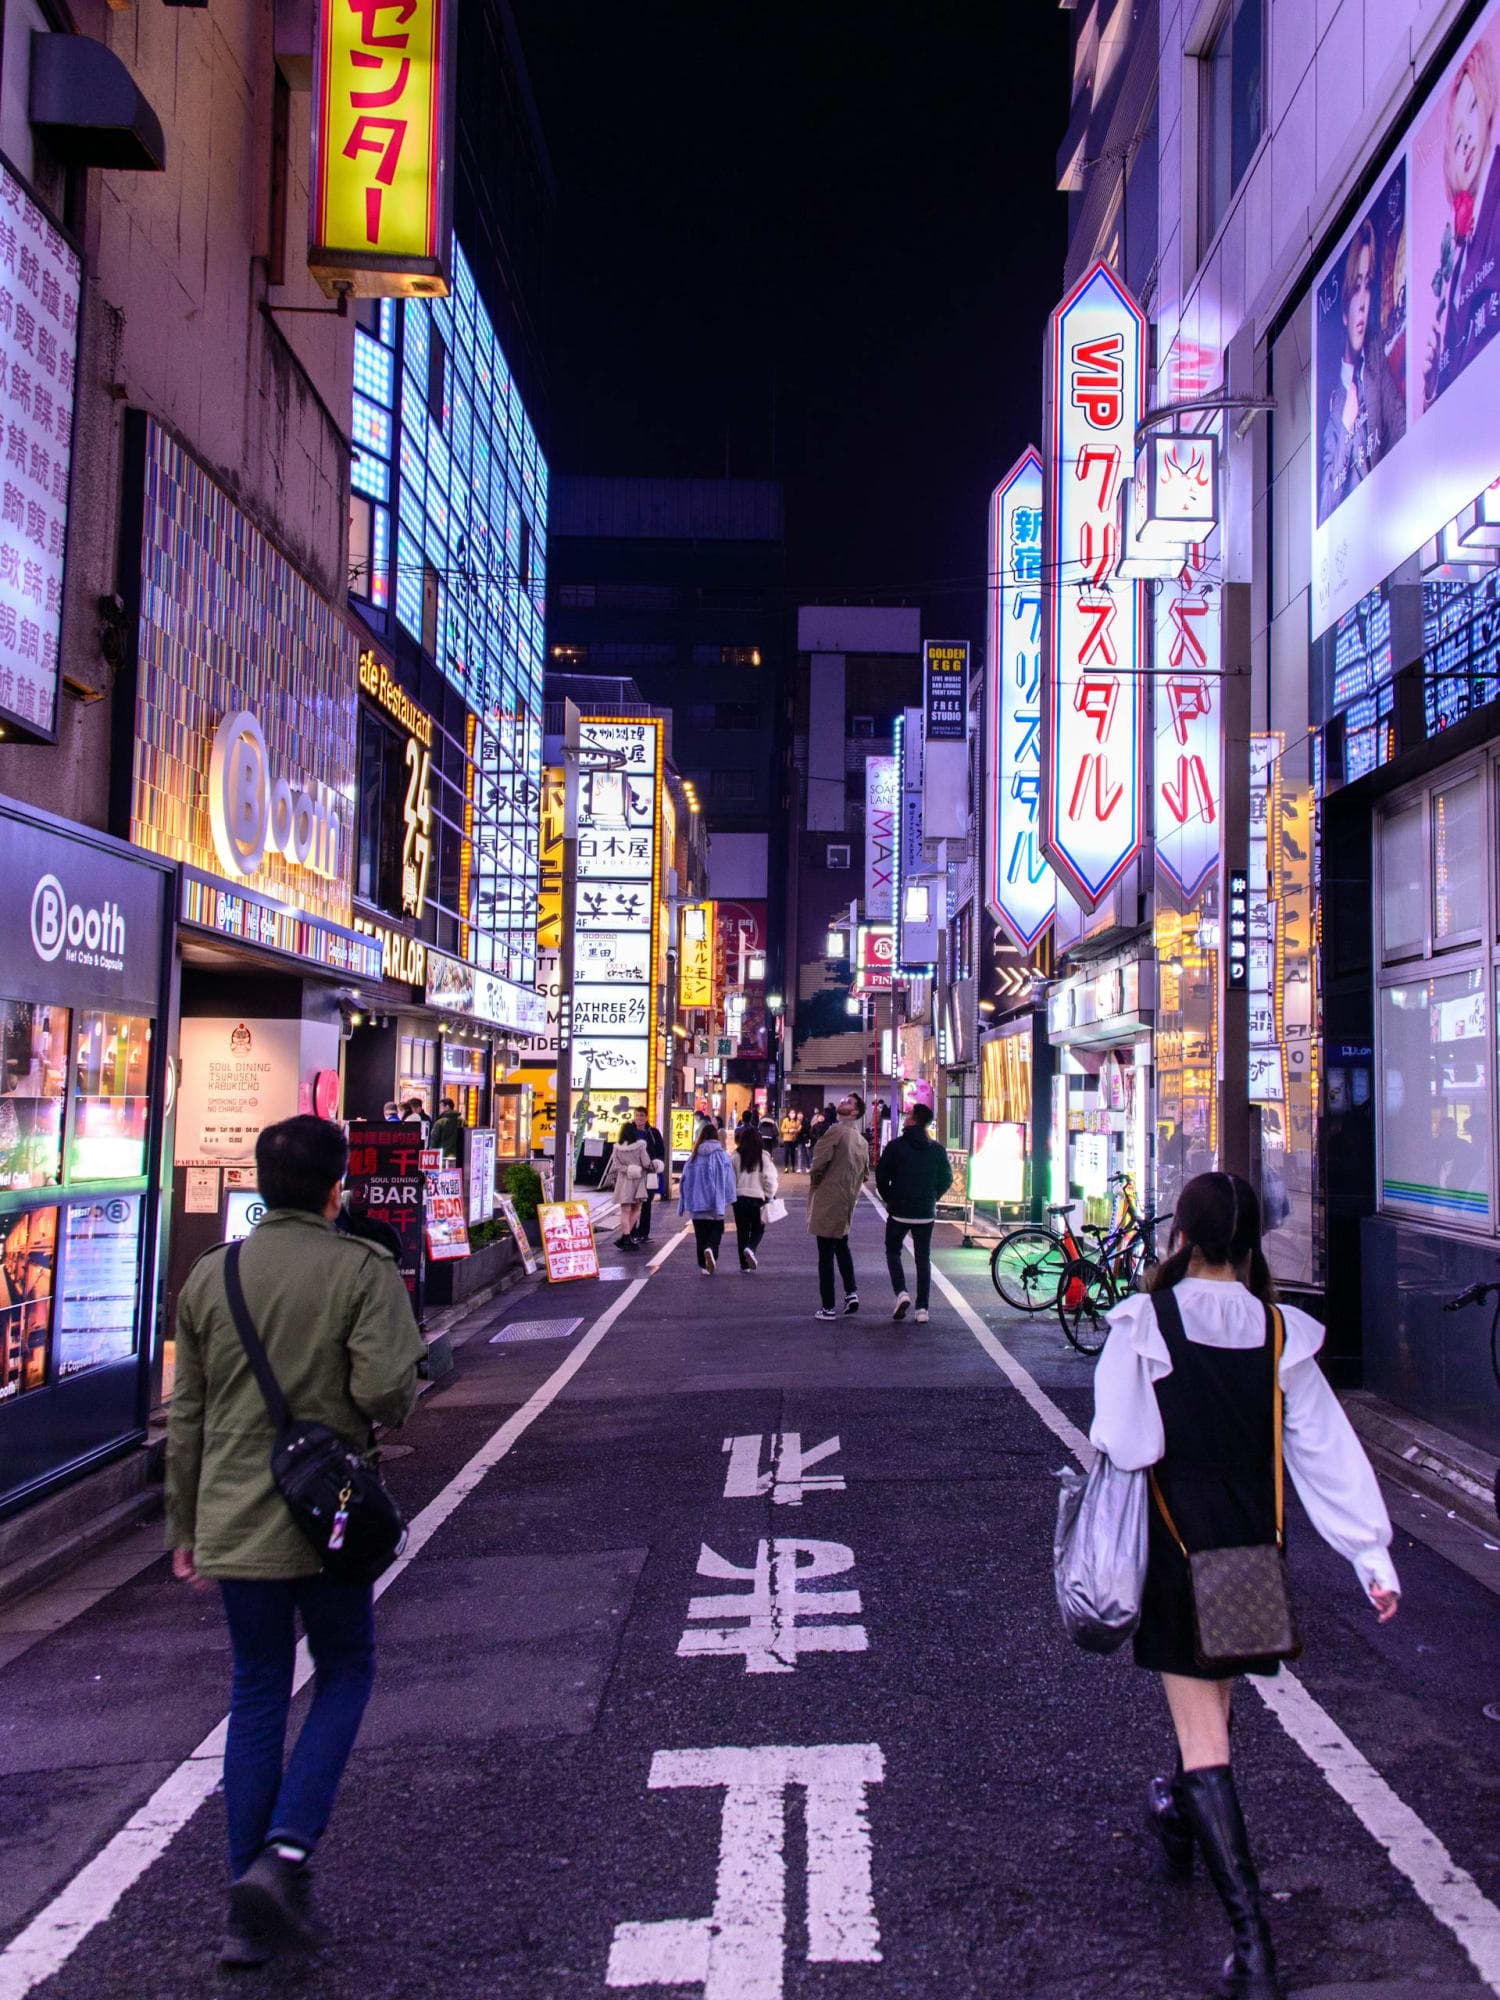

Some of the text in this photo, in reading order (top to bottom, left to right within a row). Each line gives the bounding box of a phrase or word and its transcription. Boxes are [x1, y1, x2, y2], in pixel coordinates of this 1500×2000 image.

[342, 0, 409, 244] センター
[1069, 333, 1124, 822] VIP クリスタル
[928, 647, 966, 660] GOLDEN
[932, 659, 962, 671] EGG
[360, 649, 433, 748] afe Restaurant
[933, 701, 960, 711] FREE
[931, 711, 962, 721] STUDIO
[578, 833, 651, 858] 白木屋
[872, 808, 894, 889] MAX
[577, 865, 589, 875] 5F
[31, 873, 126, 962] Booth
[576, 918, 588, 927] 4F
[575, 1001, 627, 1013] ATHREE
[575, 1013, 626, 1024] PARLOR
[573, 1024, 584, 1033] 2F
[209, 1062, 272, 1072] SOUL DINING
[208, 1082, 260, 1091] KABUKICHO
[572, 1077, 583, 1086] 1F
[370, 1176, 419, 1184] SOUL DINING
[369, 1186, 418, 1204] BAR
